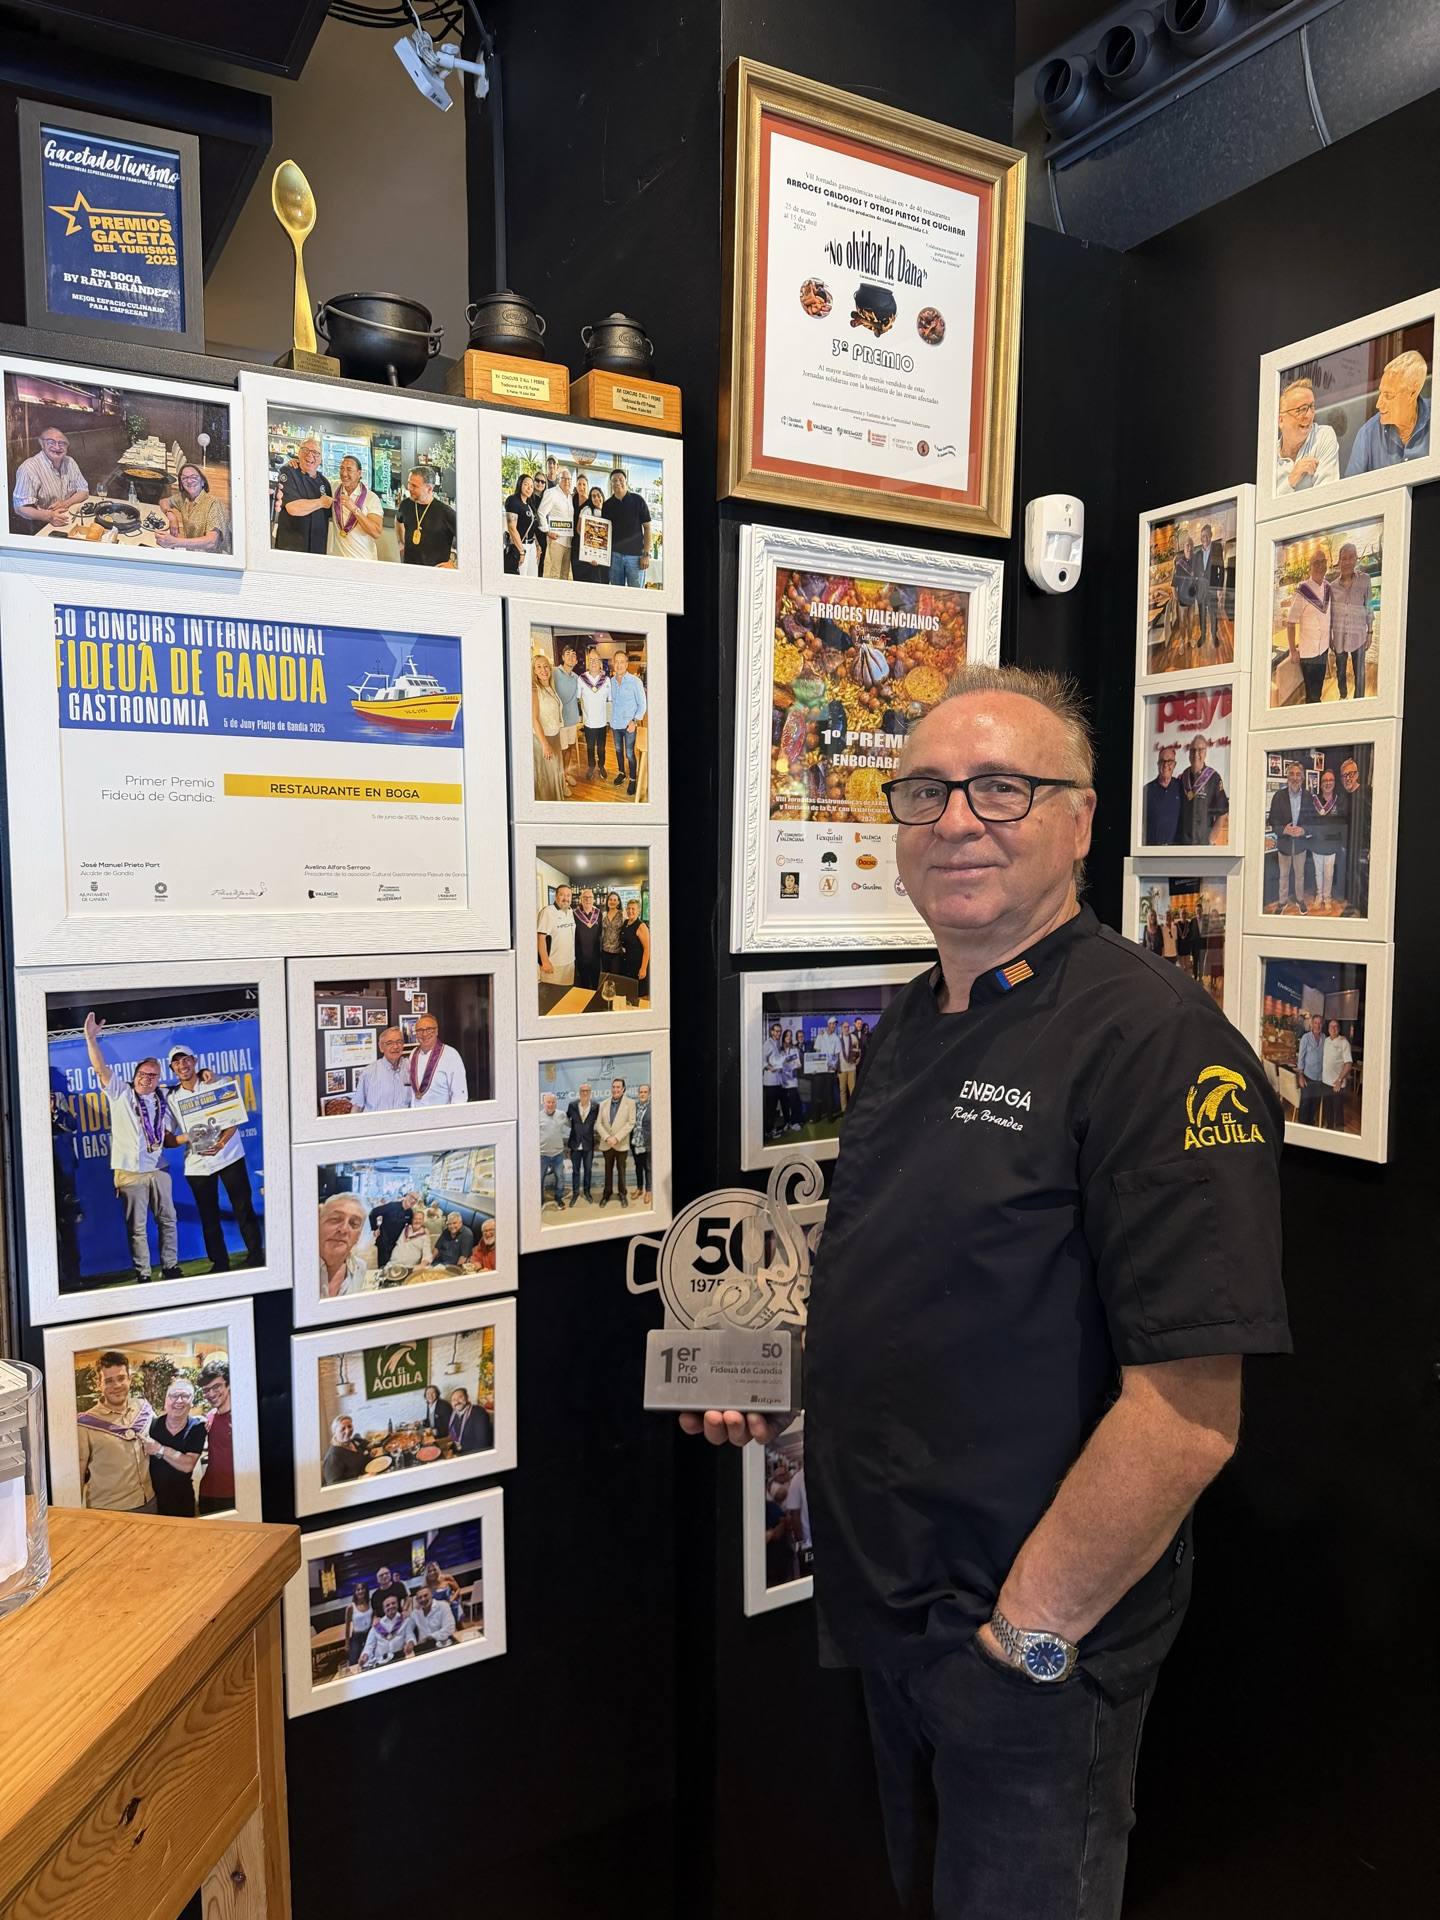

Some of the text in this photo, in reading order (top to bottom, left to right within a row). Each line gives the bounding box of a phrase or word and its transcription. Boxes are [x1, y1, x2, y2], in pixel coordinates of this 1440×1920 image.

[786, 177, 966, 237] ARROCES CALDOSOS Y OTROS PLATOS DE CUCHARA
[88, 215, 172, 232] PREMIOS
[91, 230, 175, 246] GACETA
[93, 243, 176, 255] DEL TURISMO
[846, 229, 882, 276] olvidar
[885, 236, 895, 280] la
[145, 254, 178, 266] 2025
[63, 272, 78, 283] BY
[81, 275, 112, 289] RAFA
[90, 268, 143, 284] EN-BOGA
[72, 293, 165, 313] MEJOR ESPACIO CULINARIO
[89, 302, 148, 317] PARA EMPRESAS
[852, 343, 914, 372] PREMIO
[825, 366, 841, 375] mayor
[842, 370, 861, 379] número
[885, 379, 906, 389] vendidos
[802, 370, 824, 380] Jornadas
[825, 375, 848, 386] solidarias
[904, 392, 917, 400] zonas
[918, 394, 939, 405] afectadas
[810, 601, 940, 631] ARROCES VALENCIANOS
[85, 610, 176, 644] CONCURS
[183, 617, 325, 656] INTERNACIONAL
[170, 647, 204, 696] DE
[216, 651, 327, 704] GANDIA
[69, 692, 209, 727] GASTRONOMIA
[223, 718, 325, 733] 5 de Juny Platja de Gandia 2025
[821, 729, 909, 749] 1º PREM
[833, 753, 900, 769] ENBOGABA
[125, 775, 215, 788] Primer Premio
[101, 790, 215, 803] Fideuà de Gandia:
[270, 783, 419, 798] RESTAURANTE EN BOGA
[65, 1068, 83, 1092] 50
[959, 1080, 1032, 1111] ENBOGA
[950, 1106, 979, 1124] Rafa
[1221, 1112, 1236, 1124] EL
[691, 1216, 777, 1276] 50
[761, 1343, 783, 1359] 50
[678, 1362, 698, 1373] Pre
[753, 1367, 783, 1375] Gandia
